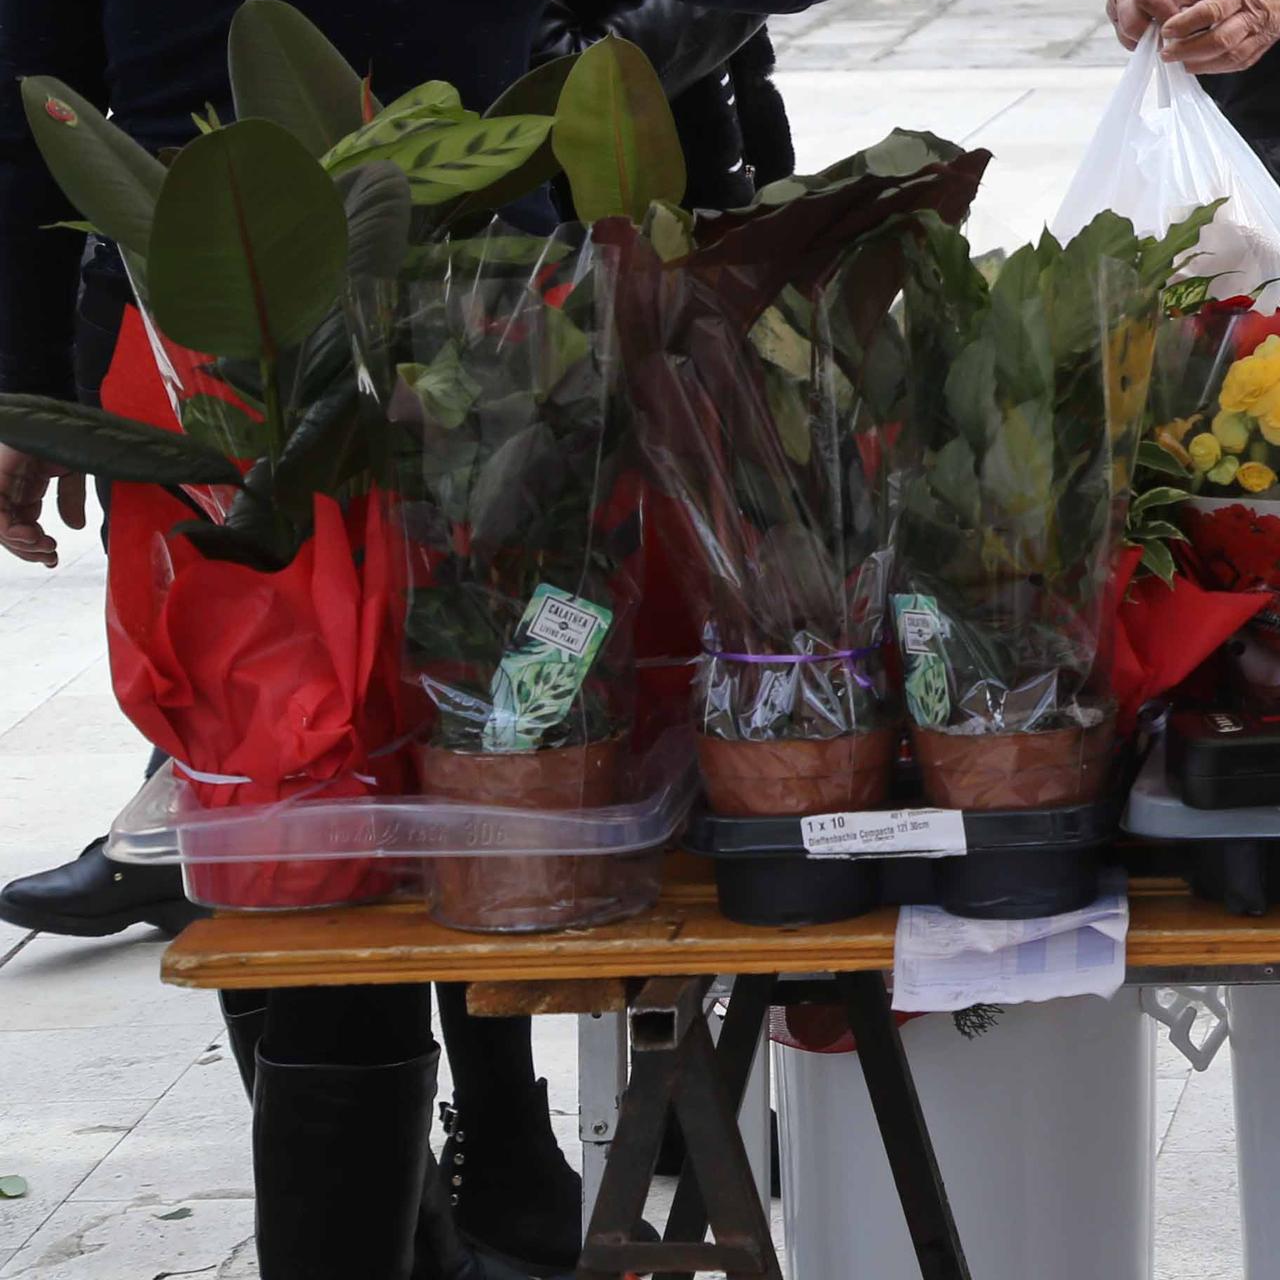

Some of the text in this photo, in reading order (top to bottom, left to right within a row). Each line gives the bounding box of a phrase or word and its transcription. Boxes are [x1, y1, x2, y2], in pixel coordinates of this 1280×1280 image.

[807, 816, 845, 833] 1 x 10
